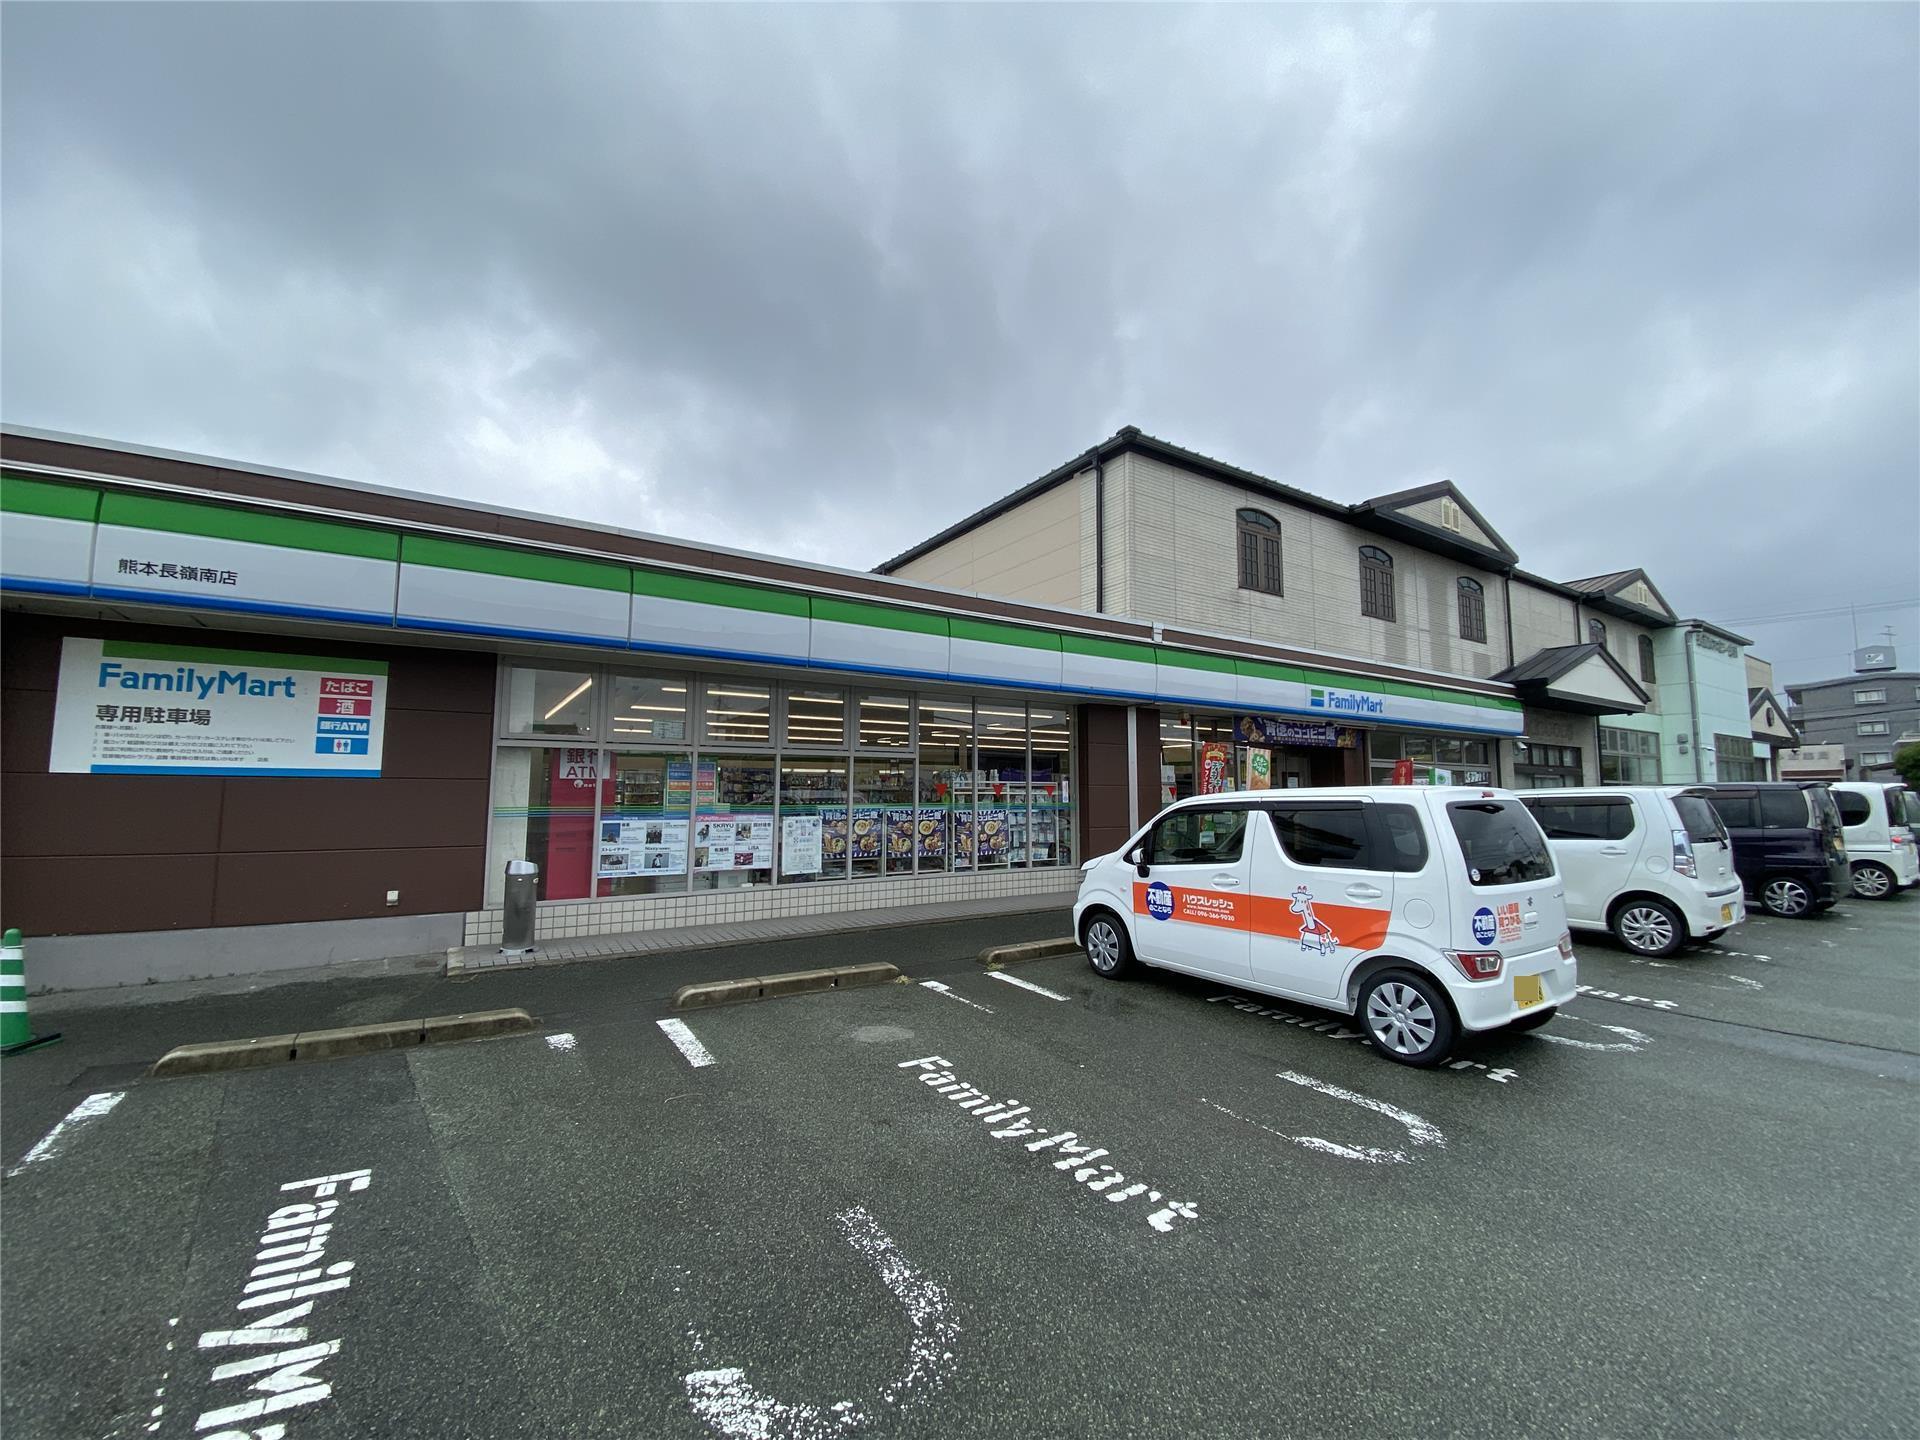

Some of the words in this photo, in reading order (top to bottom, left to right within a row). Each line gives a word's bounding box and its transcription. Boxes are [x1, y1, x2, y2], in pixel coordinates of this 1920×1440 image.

[118, 558, 238, 585] 熊本長嶺南店
[98, 663, 296, 699] FamilyMart
[325, 680, 369, 694] たばこ
[335, 699, 356, 715] 酒
[1328, 691, 1384, 713] FamilyMart
[95, 704, 212, 726] 専用駐車場
[319, 721, 368, 731] 銀行ATM
[1147, 887, 1172, 906] 不動産
[1182, 894, 1234, 910] ハウスレッシュ
[1149, 904, 1172, 914] のことなら
[1474, 914, 1495, 931] 不動産
[1475, 930, 1496, 939] のことなら
[897, 1055, 1198, 1232] FamilyMart
[195, 1168, 372, 1440] FamilyM
